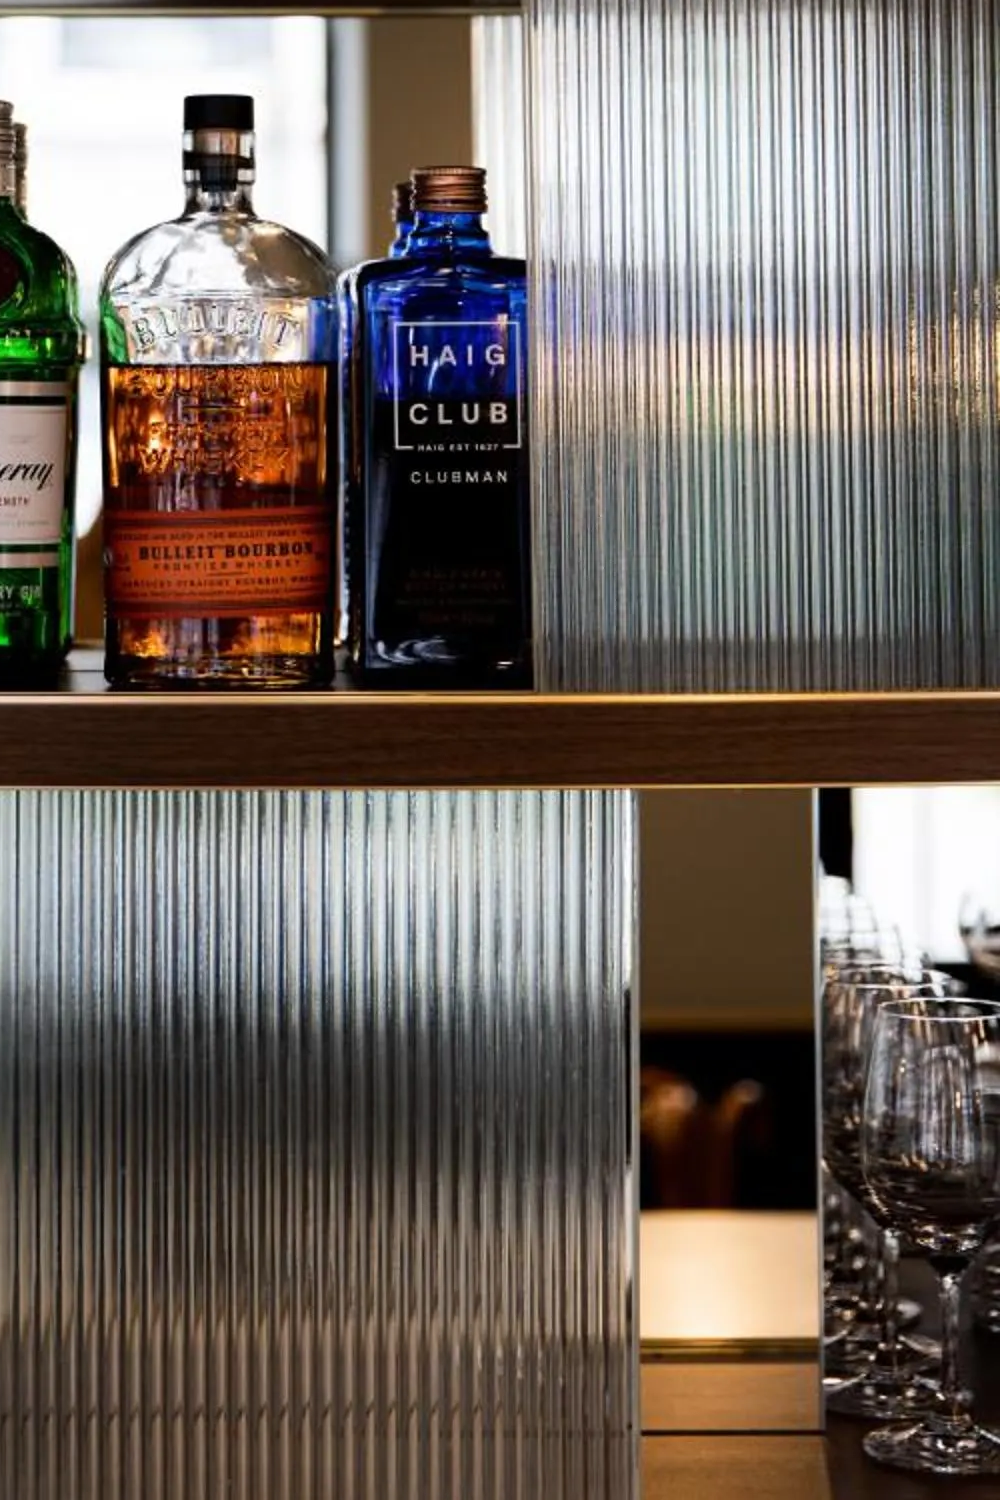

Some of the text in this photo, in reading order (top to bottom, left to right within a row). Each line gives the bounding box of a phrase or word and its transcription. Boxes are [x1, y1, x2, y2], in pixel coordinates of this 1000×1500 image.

[410, 344, 506, 367] HAIG
[409, 403, 508, 425] CLUB
[411, 471, 508, 484] CLUBMAN
[139, 545, 216, 561] BULLEIT
[225, 541, 313, 559] BOURBON
